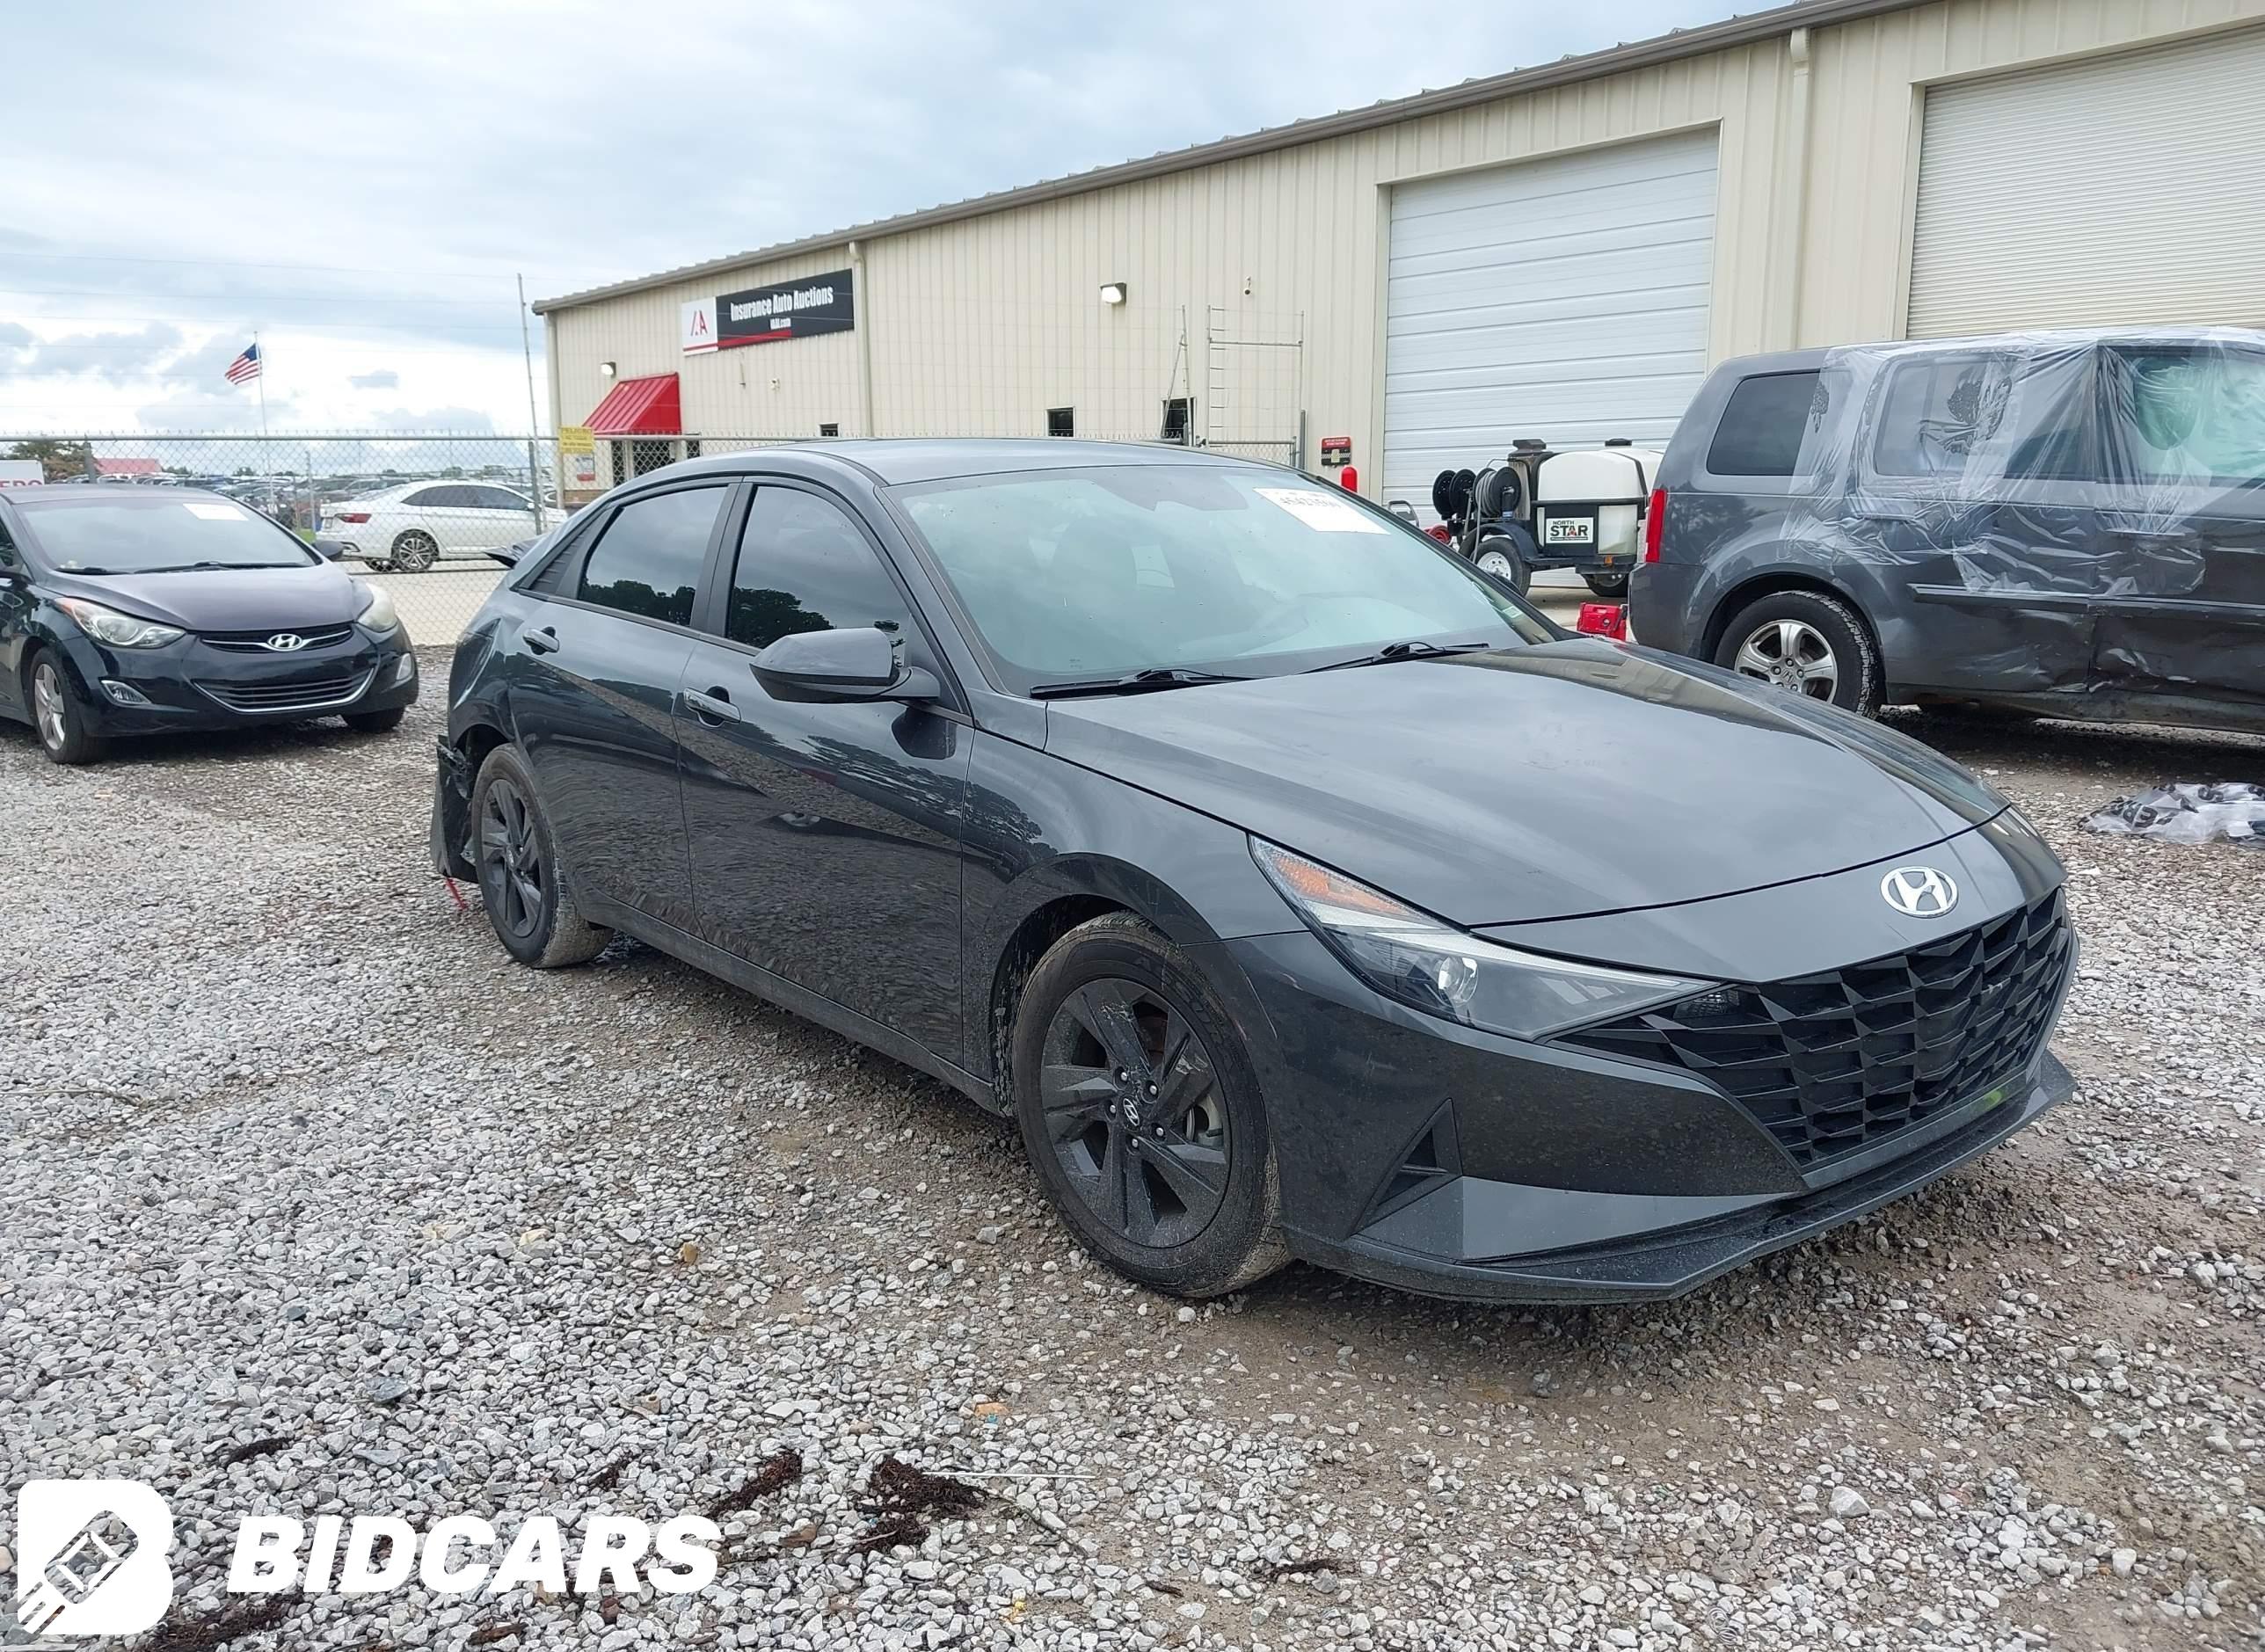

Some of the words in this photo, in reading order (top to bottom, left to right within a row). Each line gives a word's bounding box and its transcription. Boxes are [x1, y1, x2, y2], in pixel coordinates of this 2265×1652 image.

[730, 298, 772, 322] Insurance
[773, 293, 792, 314] Auto
[793, 286, 834, 309] Auctions
[1550, 525, 1588, 536] STAR
